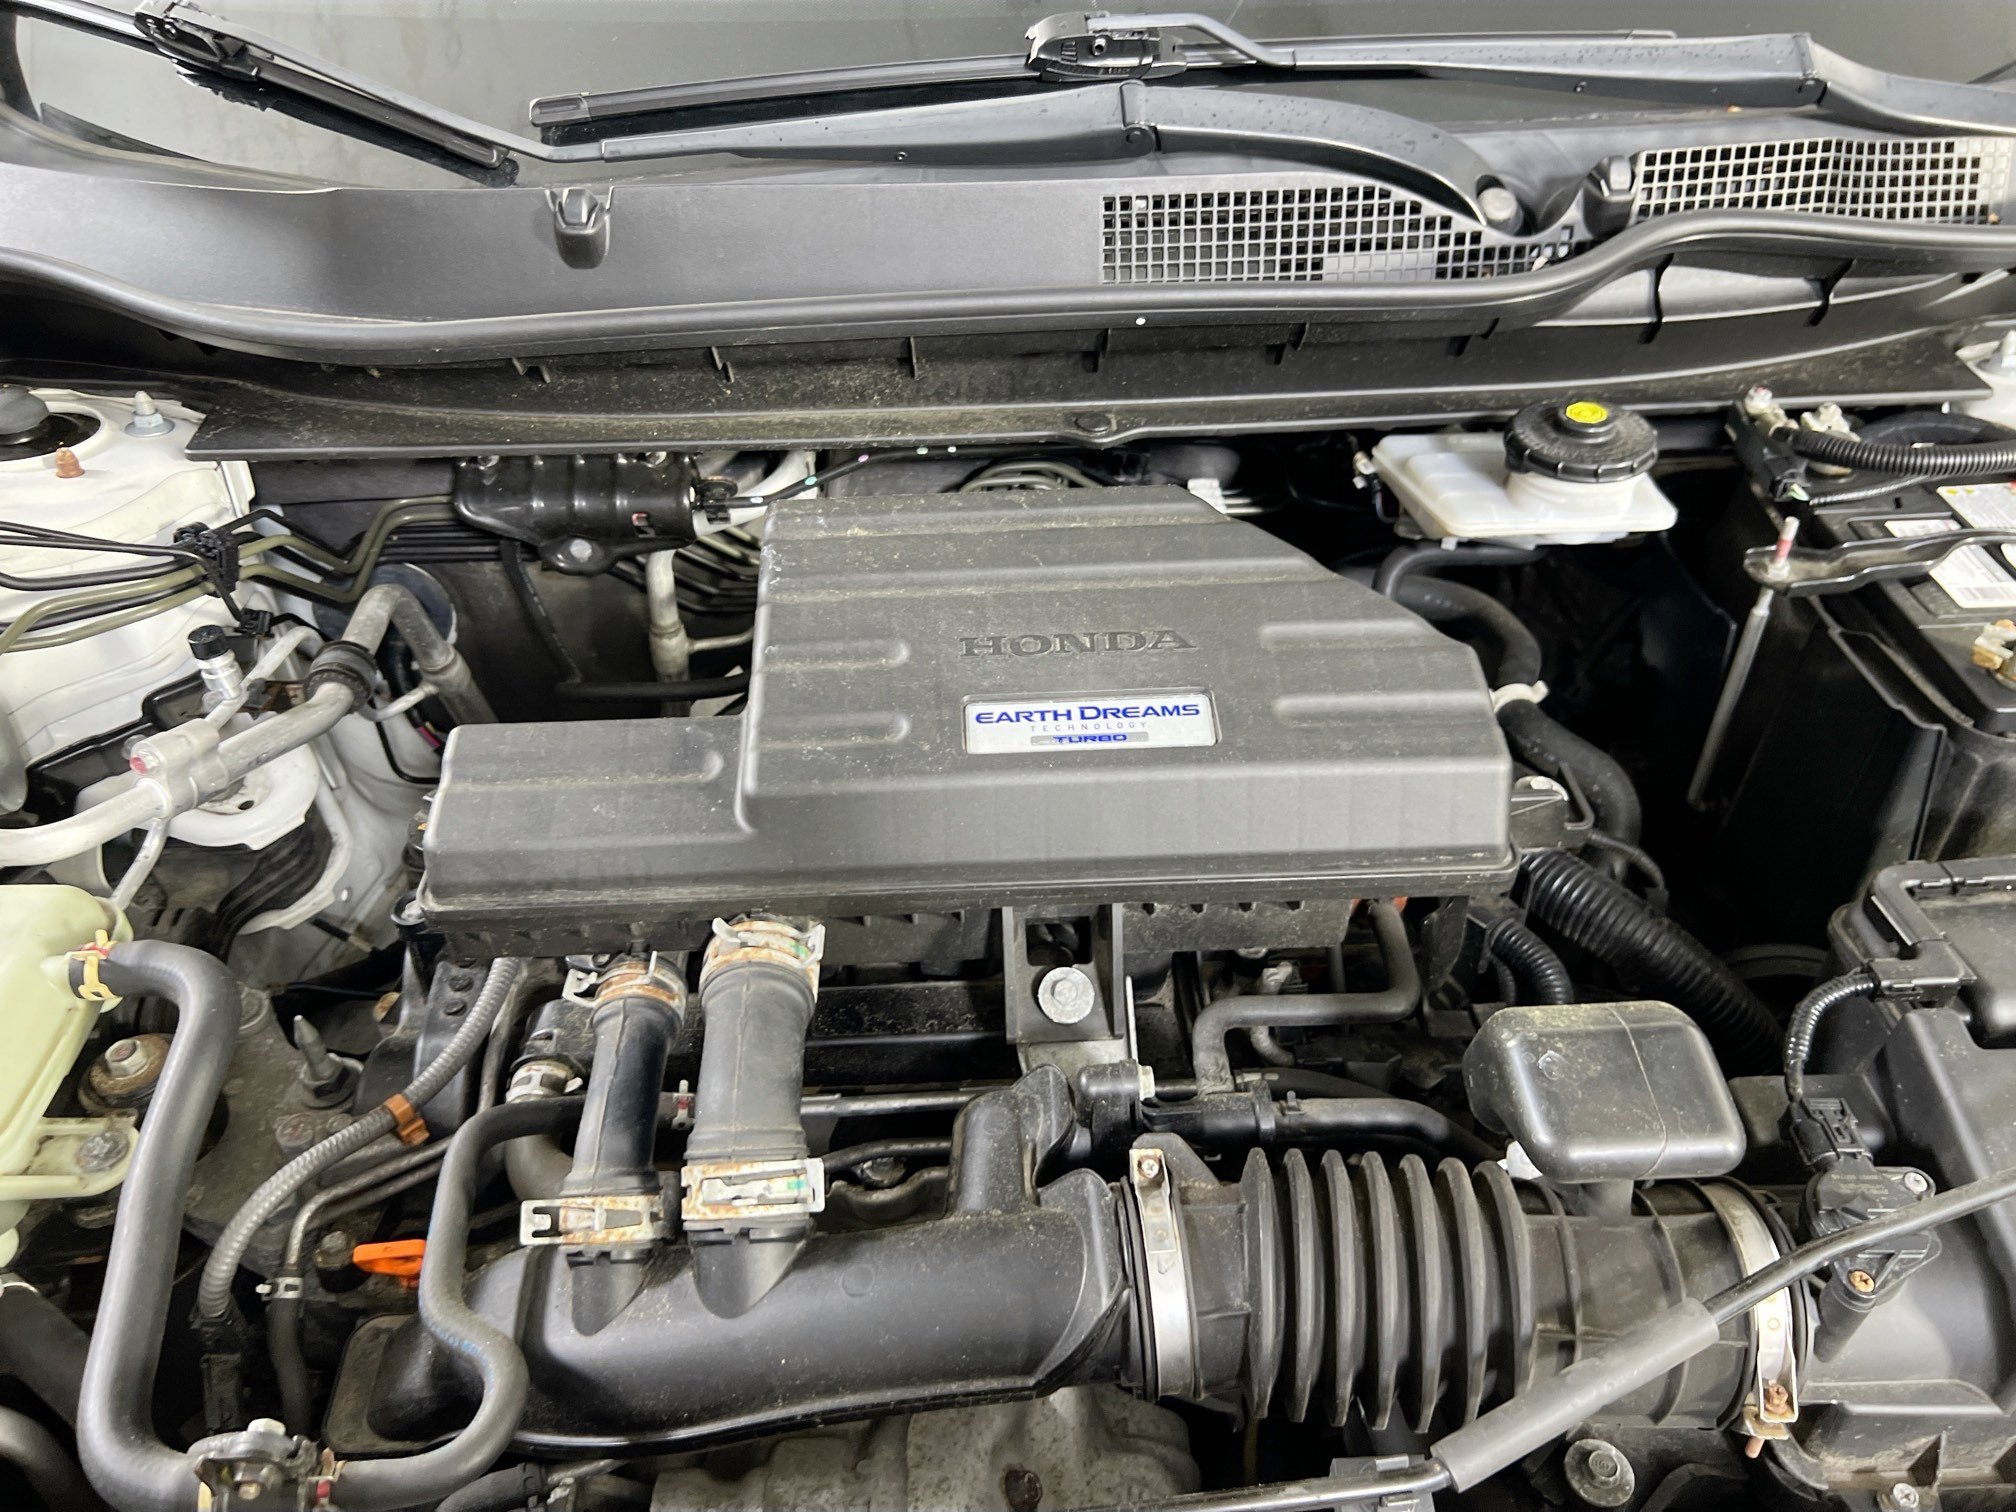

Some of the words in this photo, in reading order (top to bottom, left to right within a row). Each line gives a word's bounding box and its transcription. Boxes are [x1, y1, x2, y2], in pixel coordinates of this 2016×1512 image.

[959, 630, 1197, 657] HONDA
[975, 709, 1072, 724] EARTH
[1079, 704, 1200, 720] DREAMS
[1030, 721, 1147, 732] TECHNOLOGY
[1053, 734, 1127, 743] TURBO
